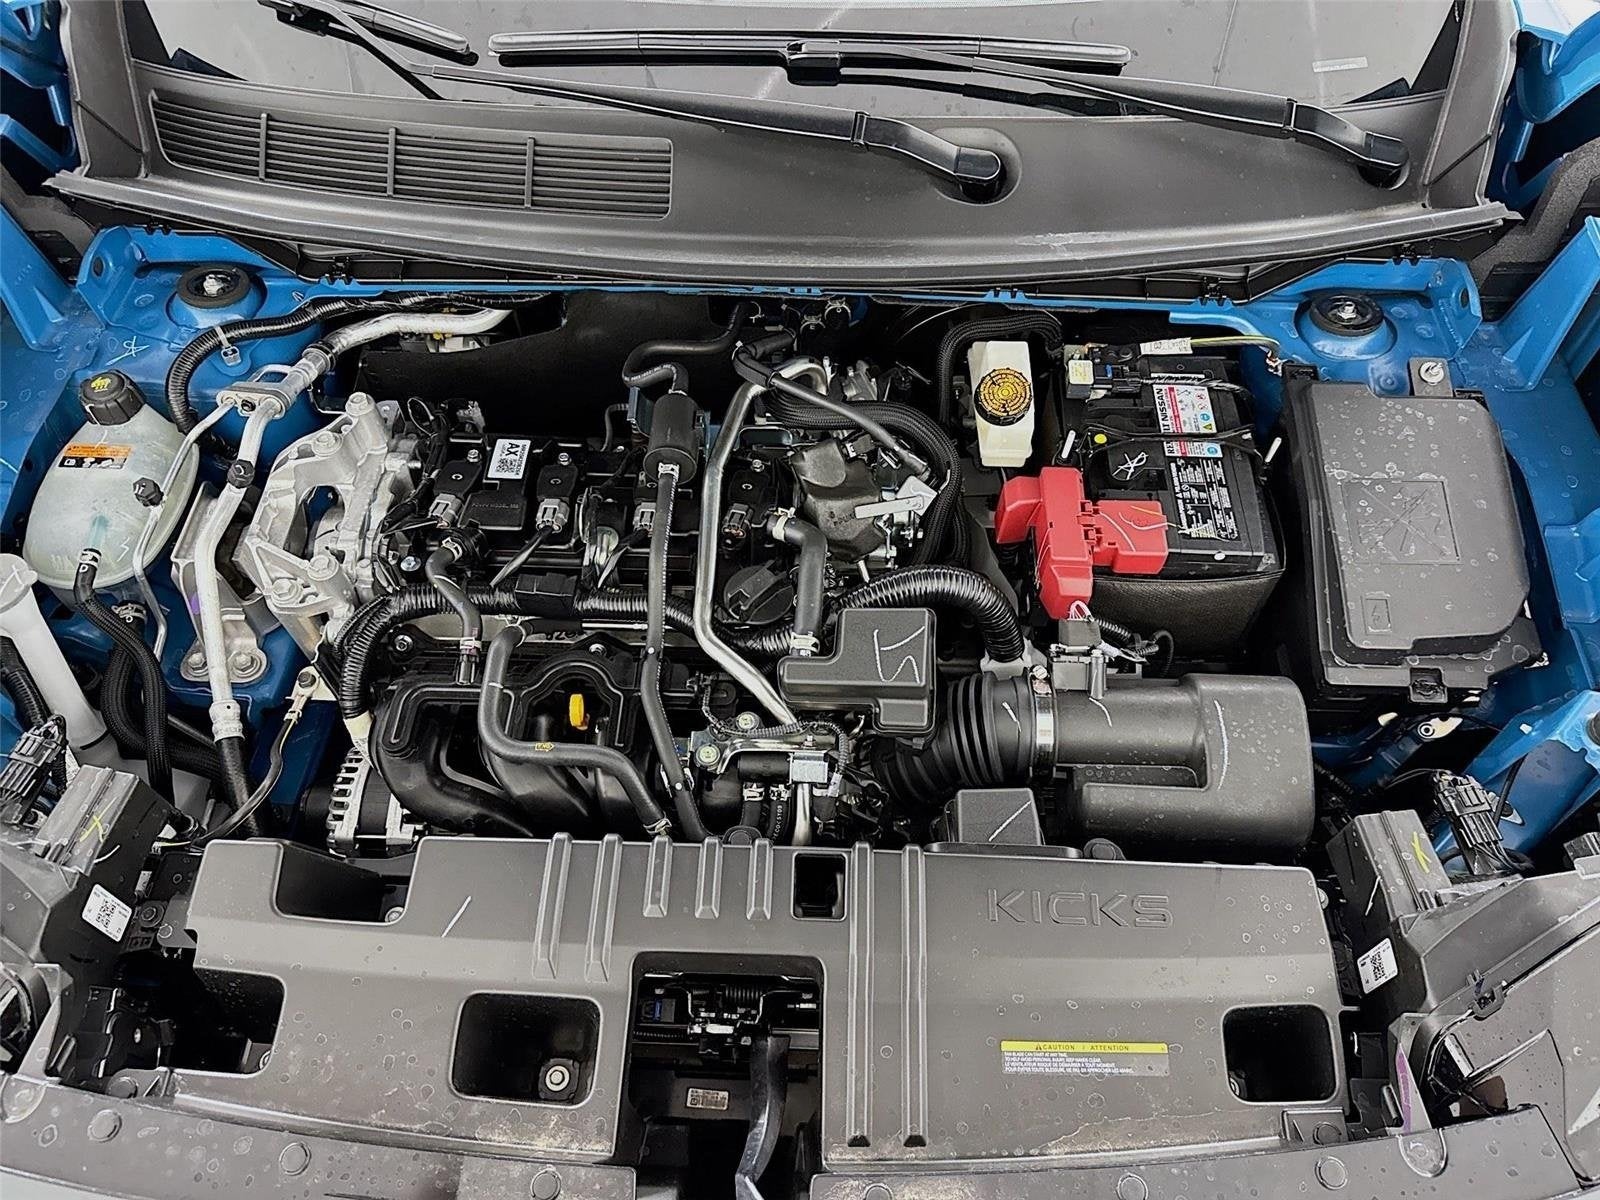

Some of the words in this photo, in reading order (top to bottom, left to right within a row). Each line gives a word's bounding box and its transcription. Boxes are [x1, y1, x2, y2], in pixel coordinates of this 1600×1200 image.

[1155, 388, 1169, 422] NISSAN
[505, 442, 520, 456] AX
[987, 889, 1174, 928] KICKS
